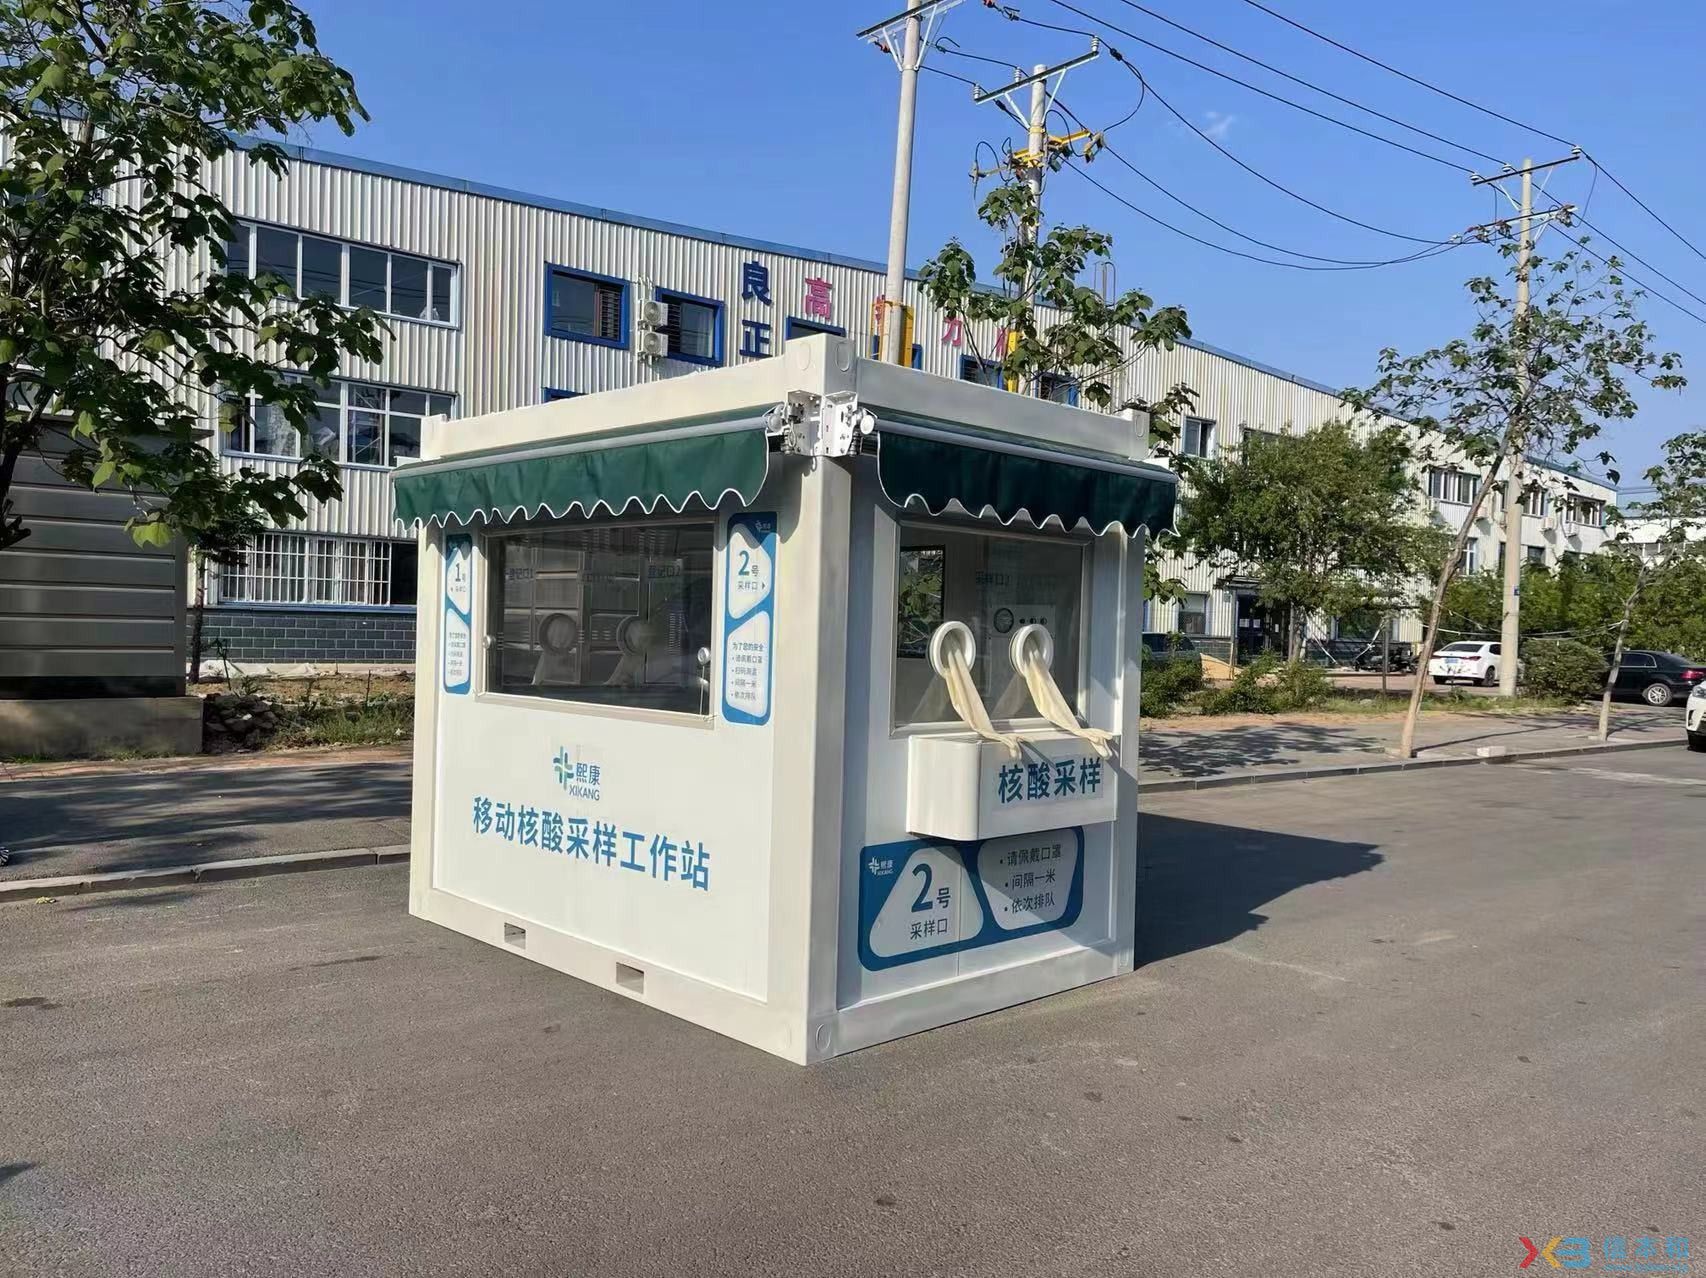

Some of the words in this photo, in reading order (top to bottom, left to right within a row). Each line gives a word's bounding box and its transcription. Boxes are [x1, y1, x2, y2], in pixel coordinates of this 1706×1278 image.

[738, 550, 760, 577] 2号
[737, 581, 758, 590] 采样口
[576, 762, 601, 786] 熙康
[998, 757, 1101, 804] 核酸采样
[569, 783, 601, 801] XIKANG
[473, 796, 711, 892] 移动核酸采样工作站
[1006, 843, 1062, 867] 请佩戴口罩
[911, 863, 951, 913] 2号
[1011, 870, 1057, 890] 间隔一米
[1011, 892, 1056, 914] 依次排队
[910, 918, 948, 941] 采样口
